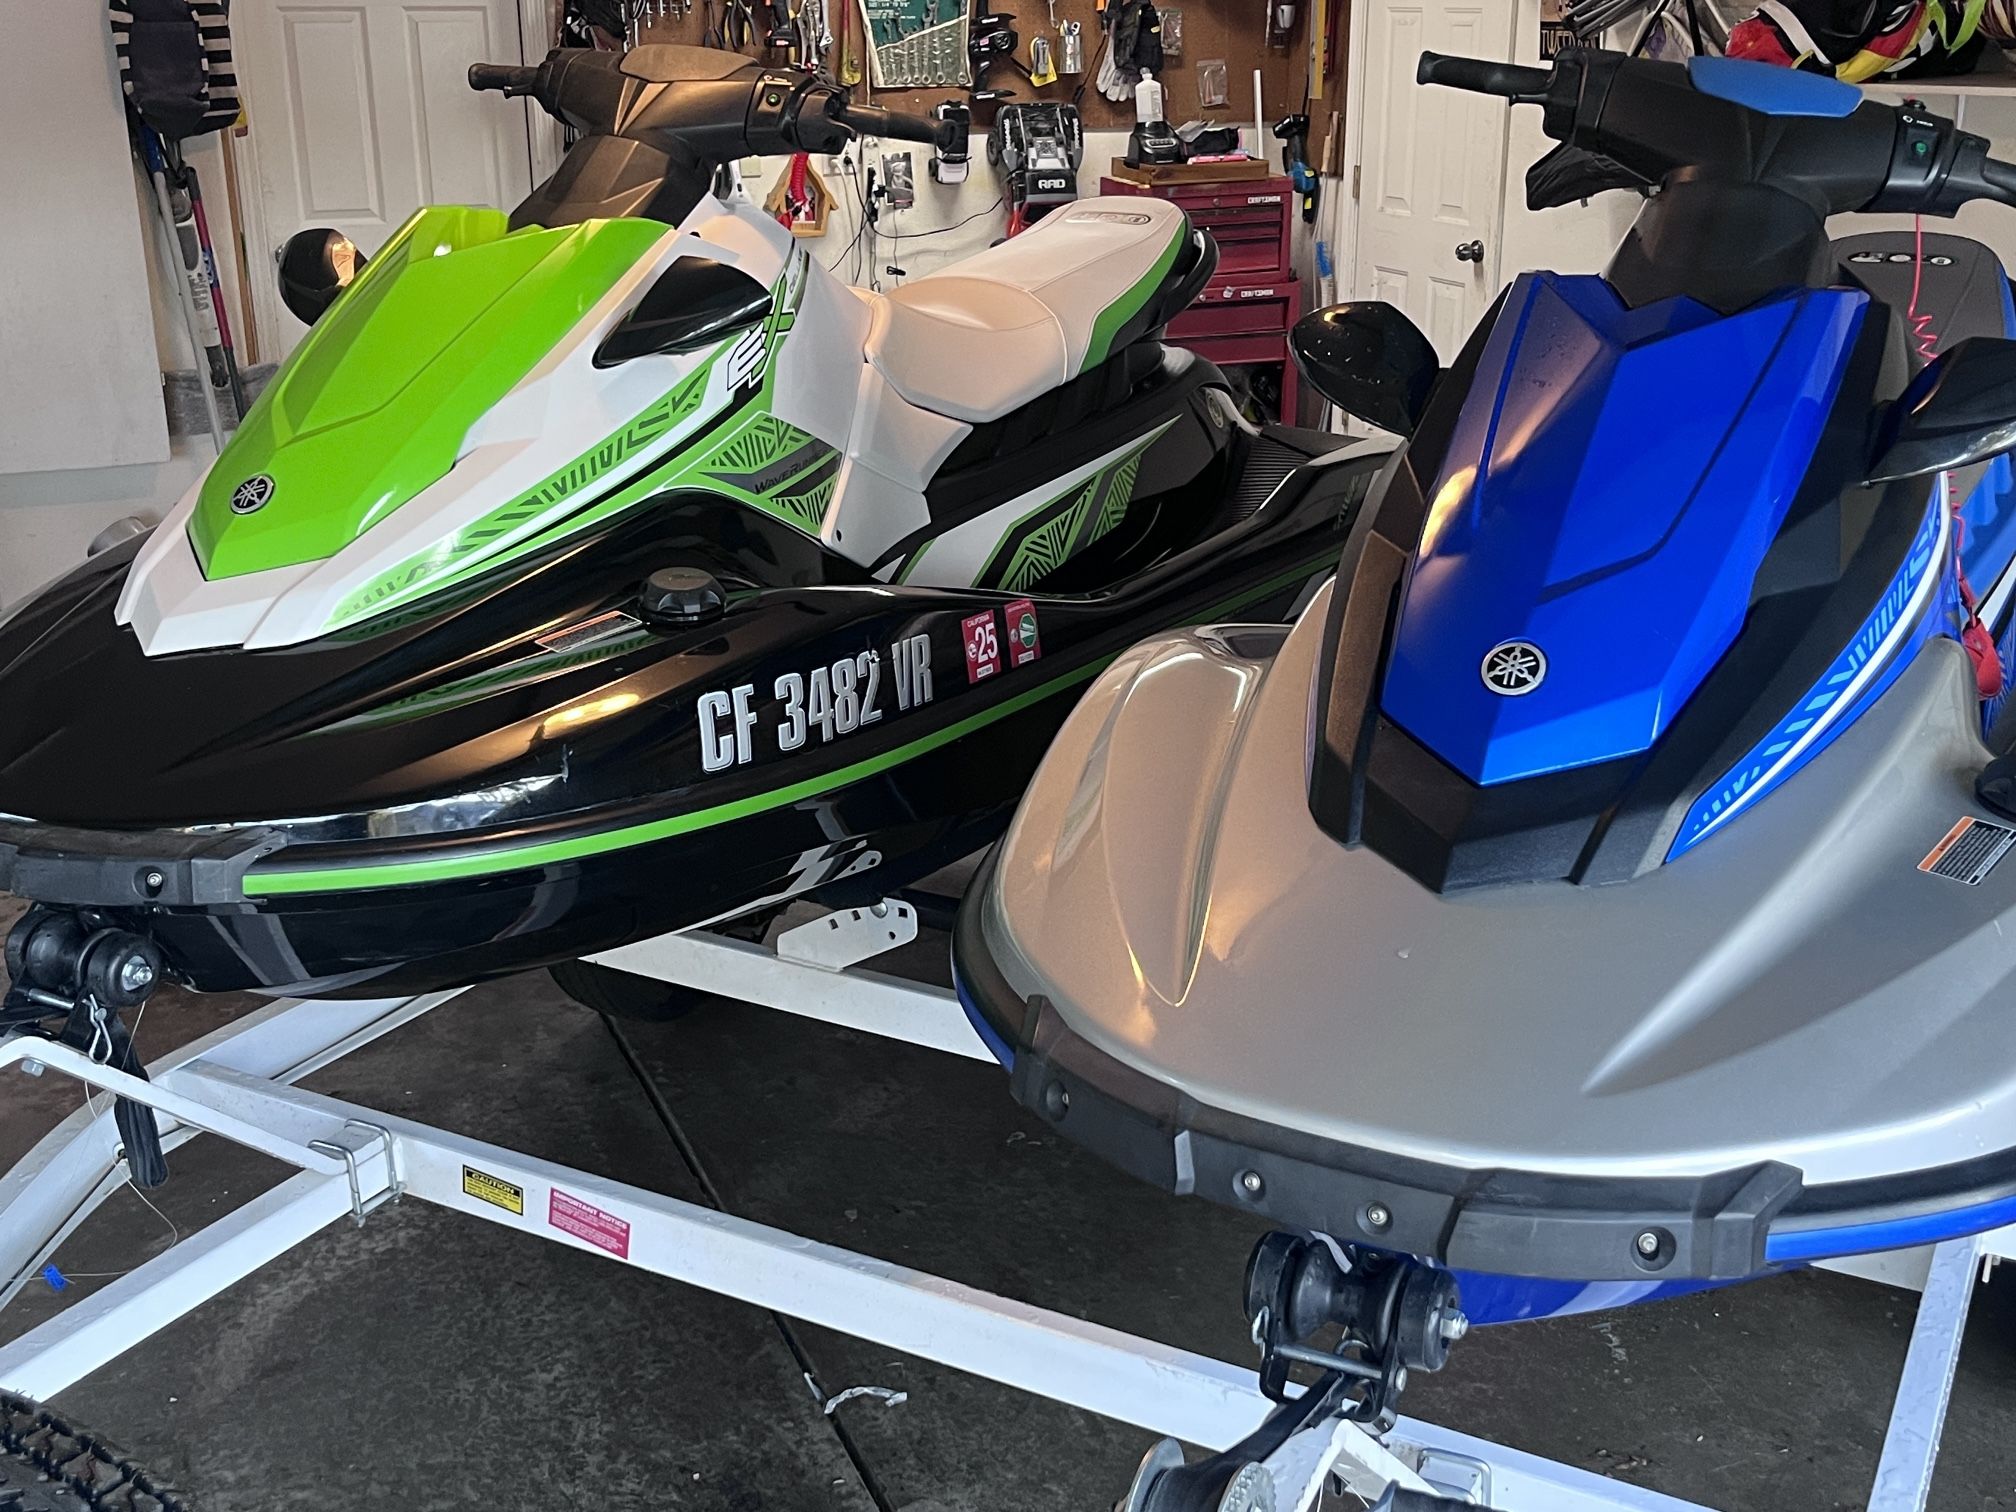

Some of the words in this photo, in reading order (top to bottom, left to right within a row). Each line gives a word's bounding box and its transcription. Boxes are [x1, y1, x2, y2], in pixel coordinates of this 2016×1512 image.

[1038, 179, 1066, 189] RAD
[975, 622, 998, 664] 25
[697, 683, 758, 775] CF
[774, 649, 883, 751] 3482
[891, 633, 934, 712] VR
[471, 1172, 515, 1195] CAUTION
[553, 1190, 598, 1216] IMPORTANT
[599, 1210, 628, 1230] NOTICE
